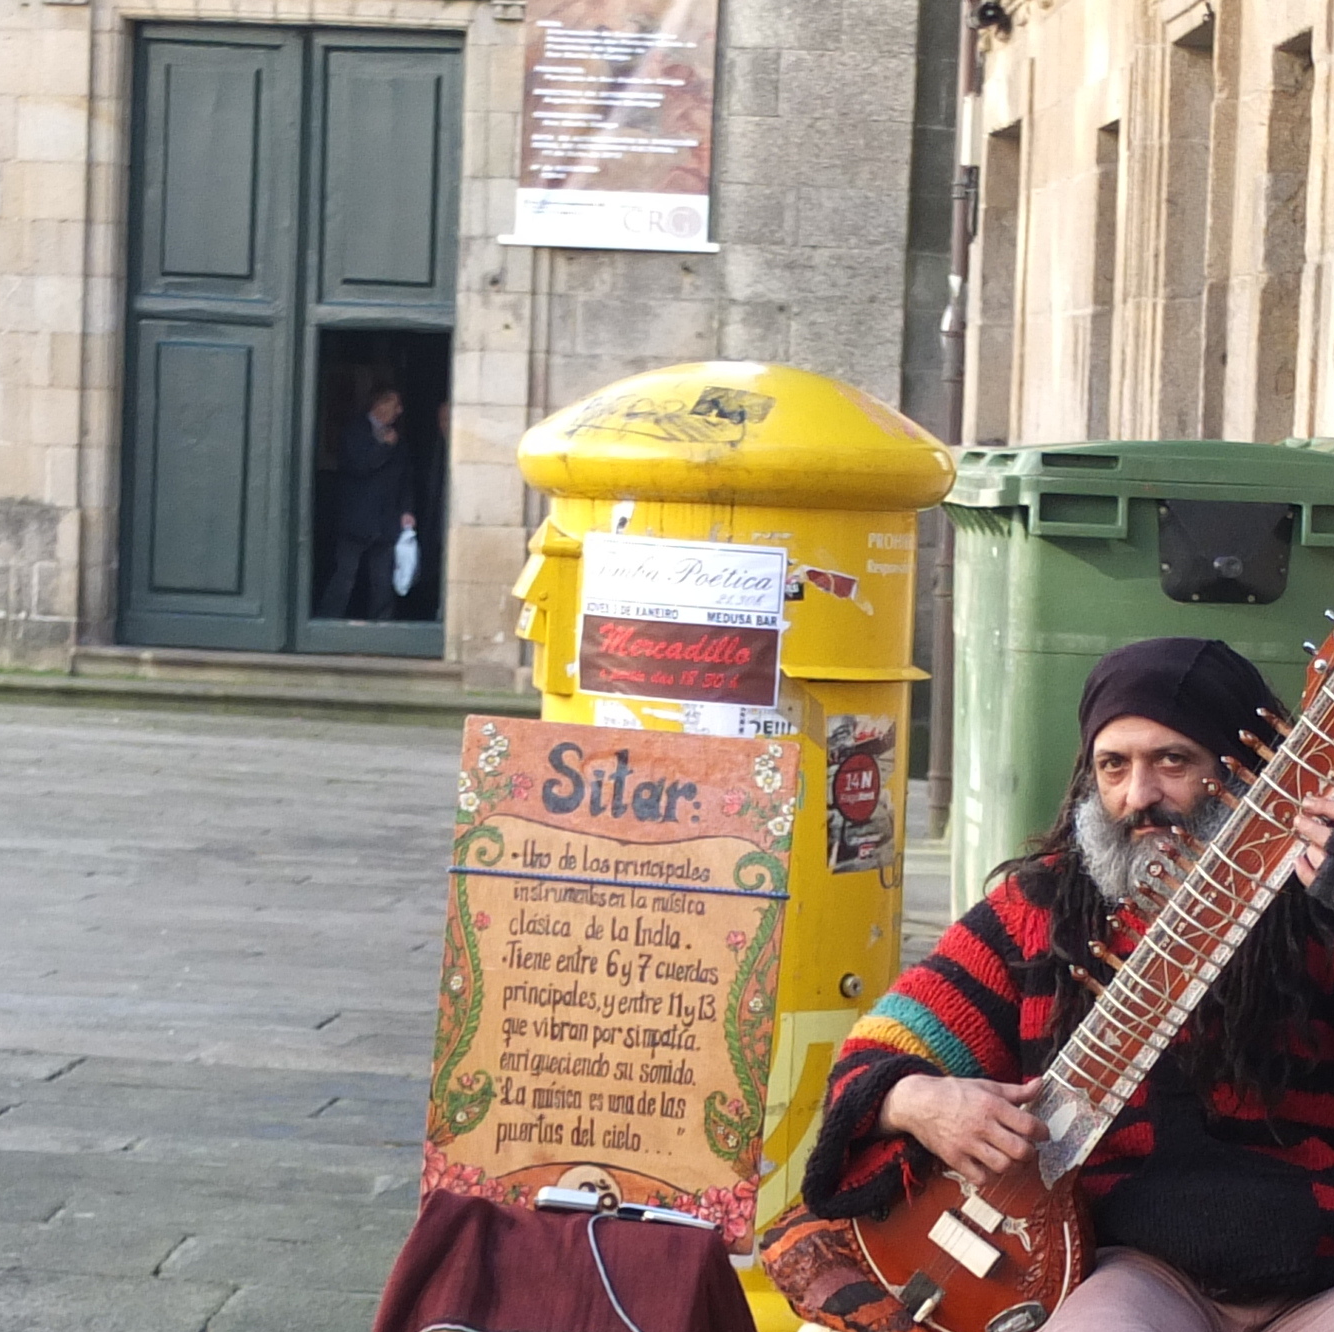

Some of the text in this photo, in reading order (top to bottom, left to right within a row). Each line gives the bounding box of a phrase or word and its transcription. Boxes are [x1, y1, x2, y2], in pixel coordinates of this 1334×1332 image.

[667, 558, 774, 591] Poética
[707, 612, 753, 624] MEDUSA
[756, 616, 777, 626] BAR
[598, 623, 752, 665] Mercadillo
[542, 741, 701, 824] Sitar:
[559, 842, 577, 870] de
[582, 845, 610, 873] los
[614, 858, 710, 884] principales
[608, 894, 625, 908] en
[631, 888, 647, 909] la
[652, 892, 705, 915] música
[509, 909, 571, 936] clásica
[585, 916, 604, 940] de
[611, 917, 628, 941] la
[556, 945, 598, 974] entre
[606, 949, 621, 977] 6
[620, 960, 632, 986] y
[638, 954, 652, 982] 7
[655, 959, 718, 985] cuerdas
[602, 994, 615, 1018] y
[618, 991, 663, 1015] entre
[667, 994, 682, 1017] 11
[682, 1005, 695, 1026] y
[502, 1017, 528, 1047] que
[533, 1017, 588, 1041] vibran
[593, 1024, 622, 1048] por
[500, 1050, 696, 1086] enriqueciendo su sonido.
[533, 1082, 581, 1110] música
[589, 1090, 603, 1111] es
[608, 1094, 634, 1115] una
[638, 1090, 656, 1115] de
[661, 1091, 686, 1119] las
[495, 1114, 564, 1154] puertas
[571, 1116, 595, 1146] del
